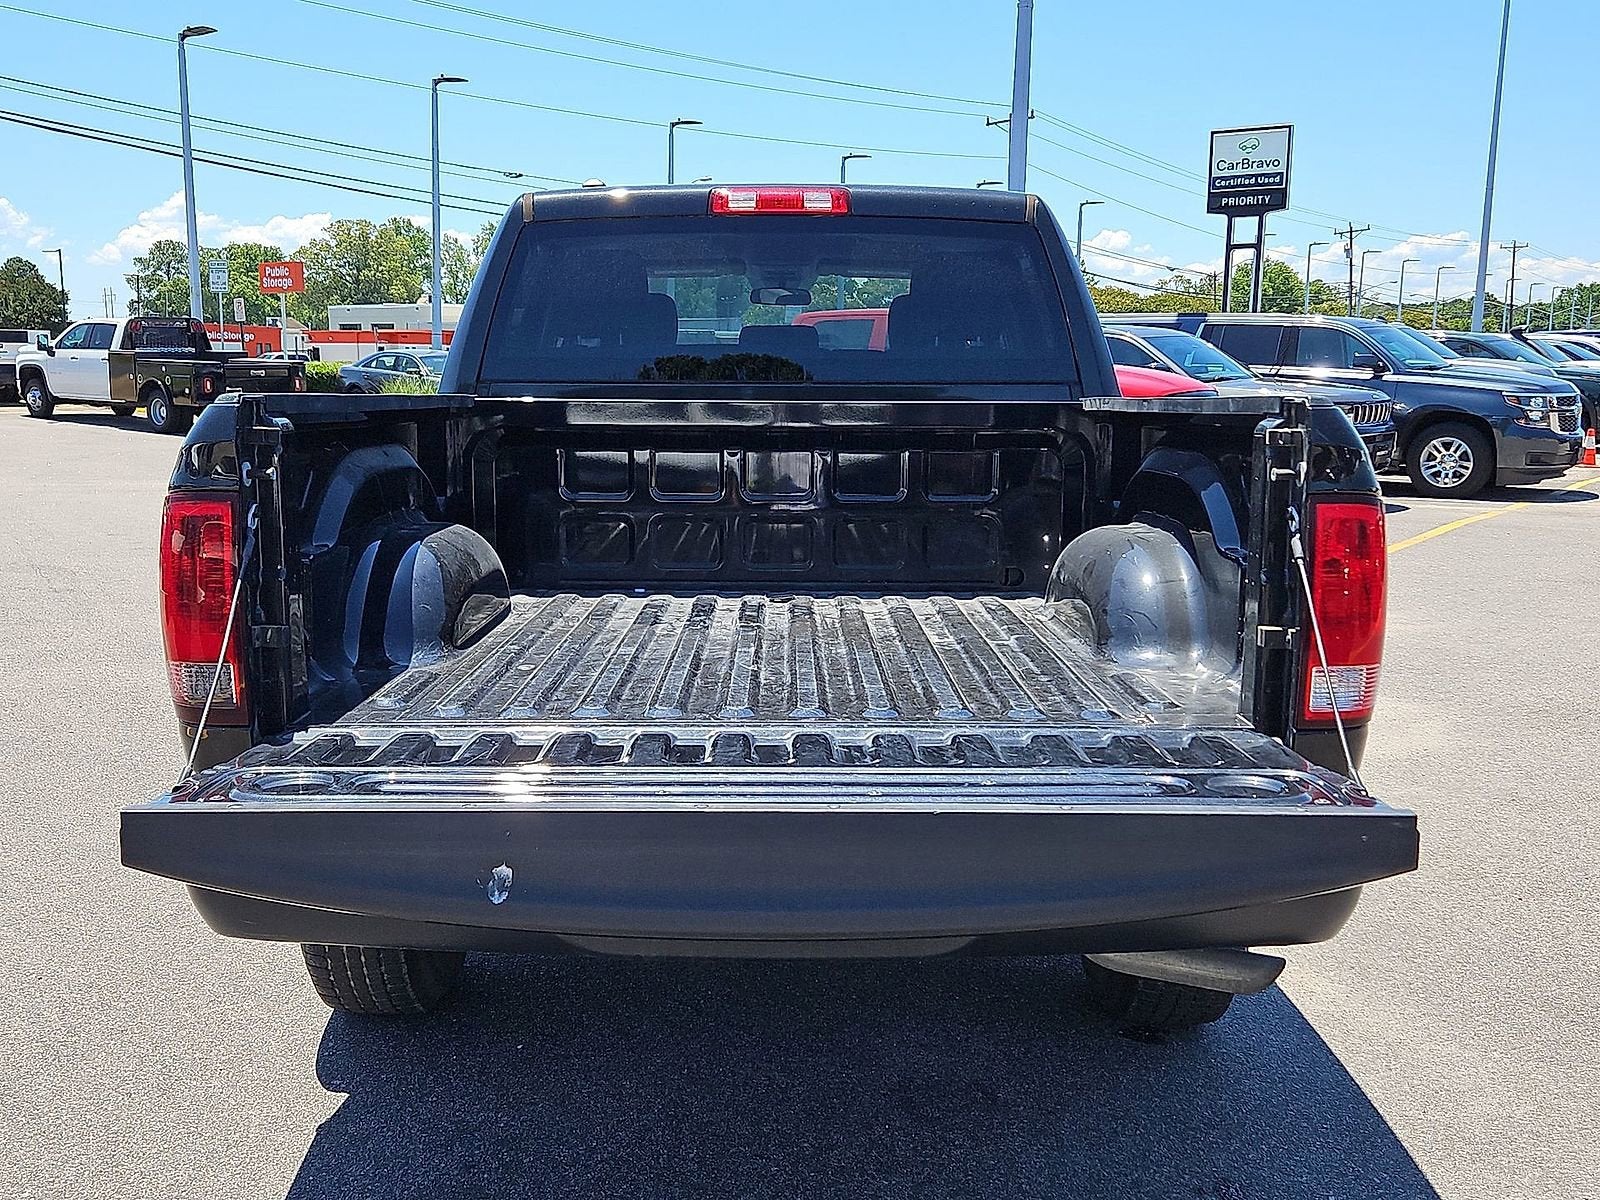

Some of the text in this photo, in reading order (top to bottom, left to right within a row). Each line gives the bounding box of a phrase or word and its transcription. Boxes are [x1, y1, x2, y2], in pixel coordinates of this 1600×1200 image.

[1216, 158, 1281, 171] CarBravo
[1215, 175, 1281, 187] Certified Used
[1221, 195, 1271, 207] PRIORITY
[265, 266, 290, 276] Public
[263, 277, 293, 289] Storage
[207, 331, 222, 340] blic
